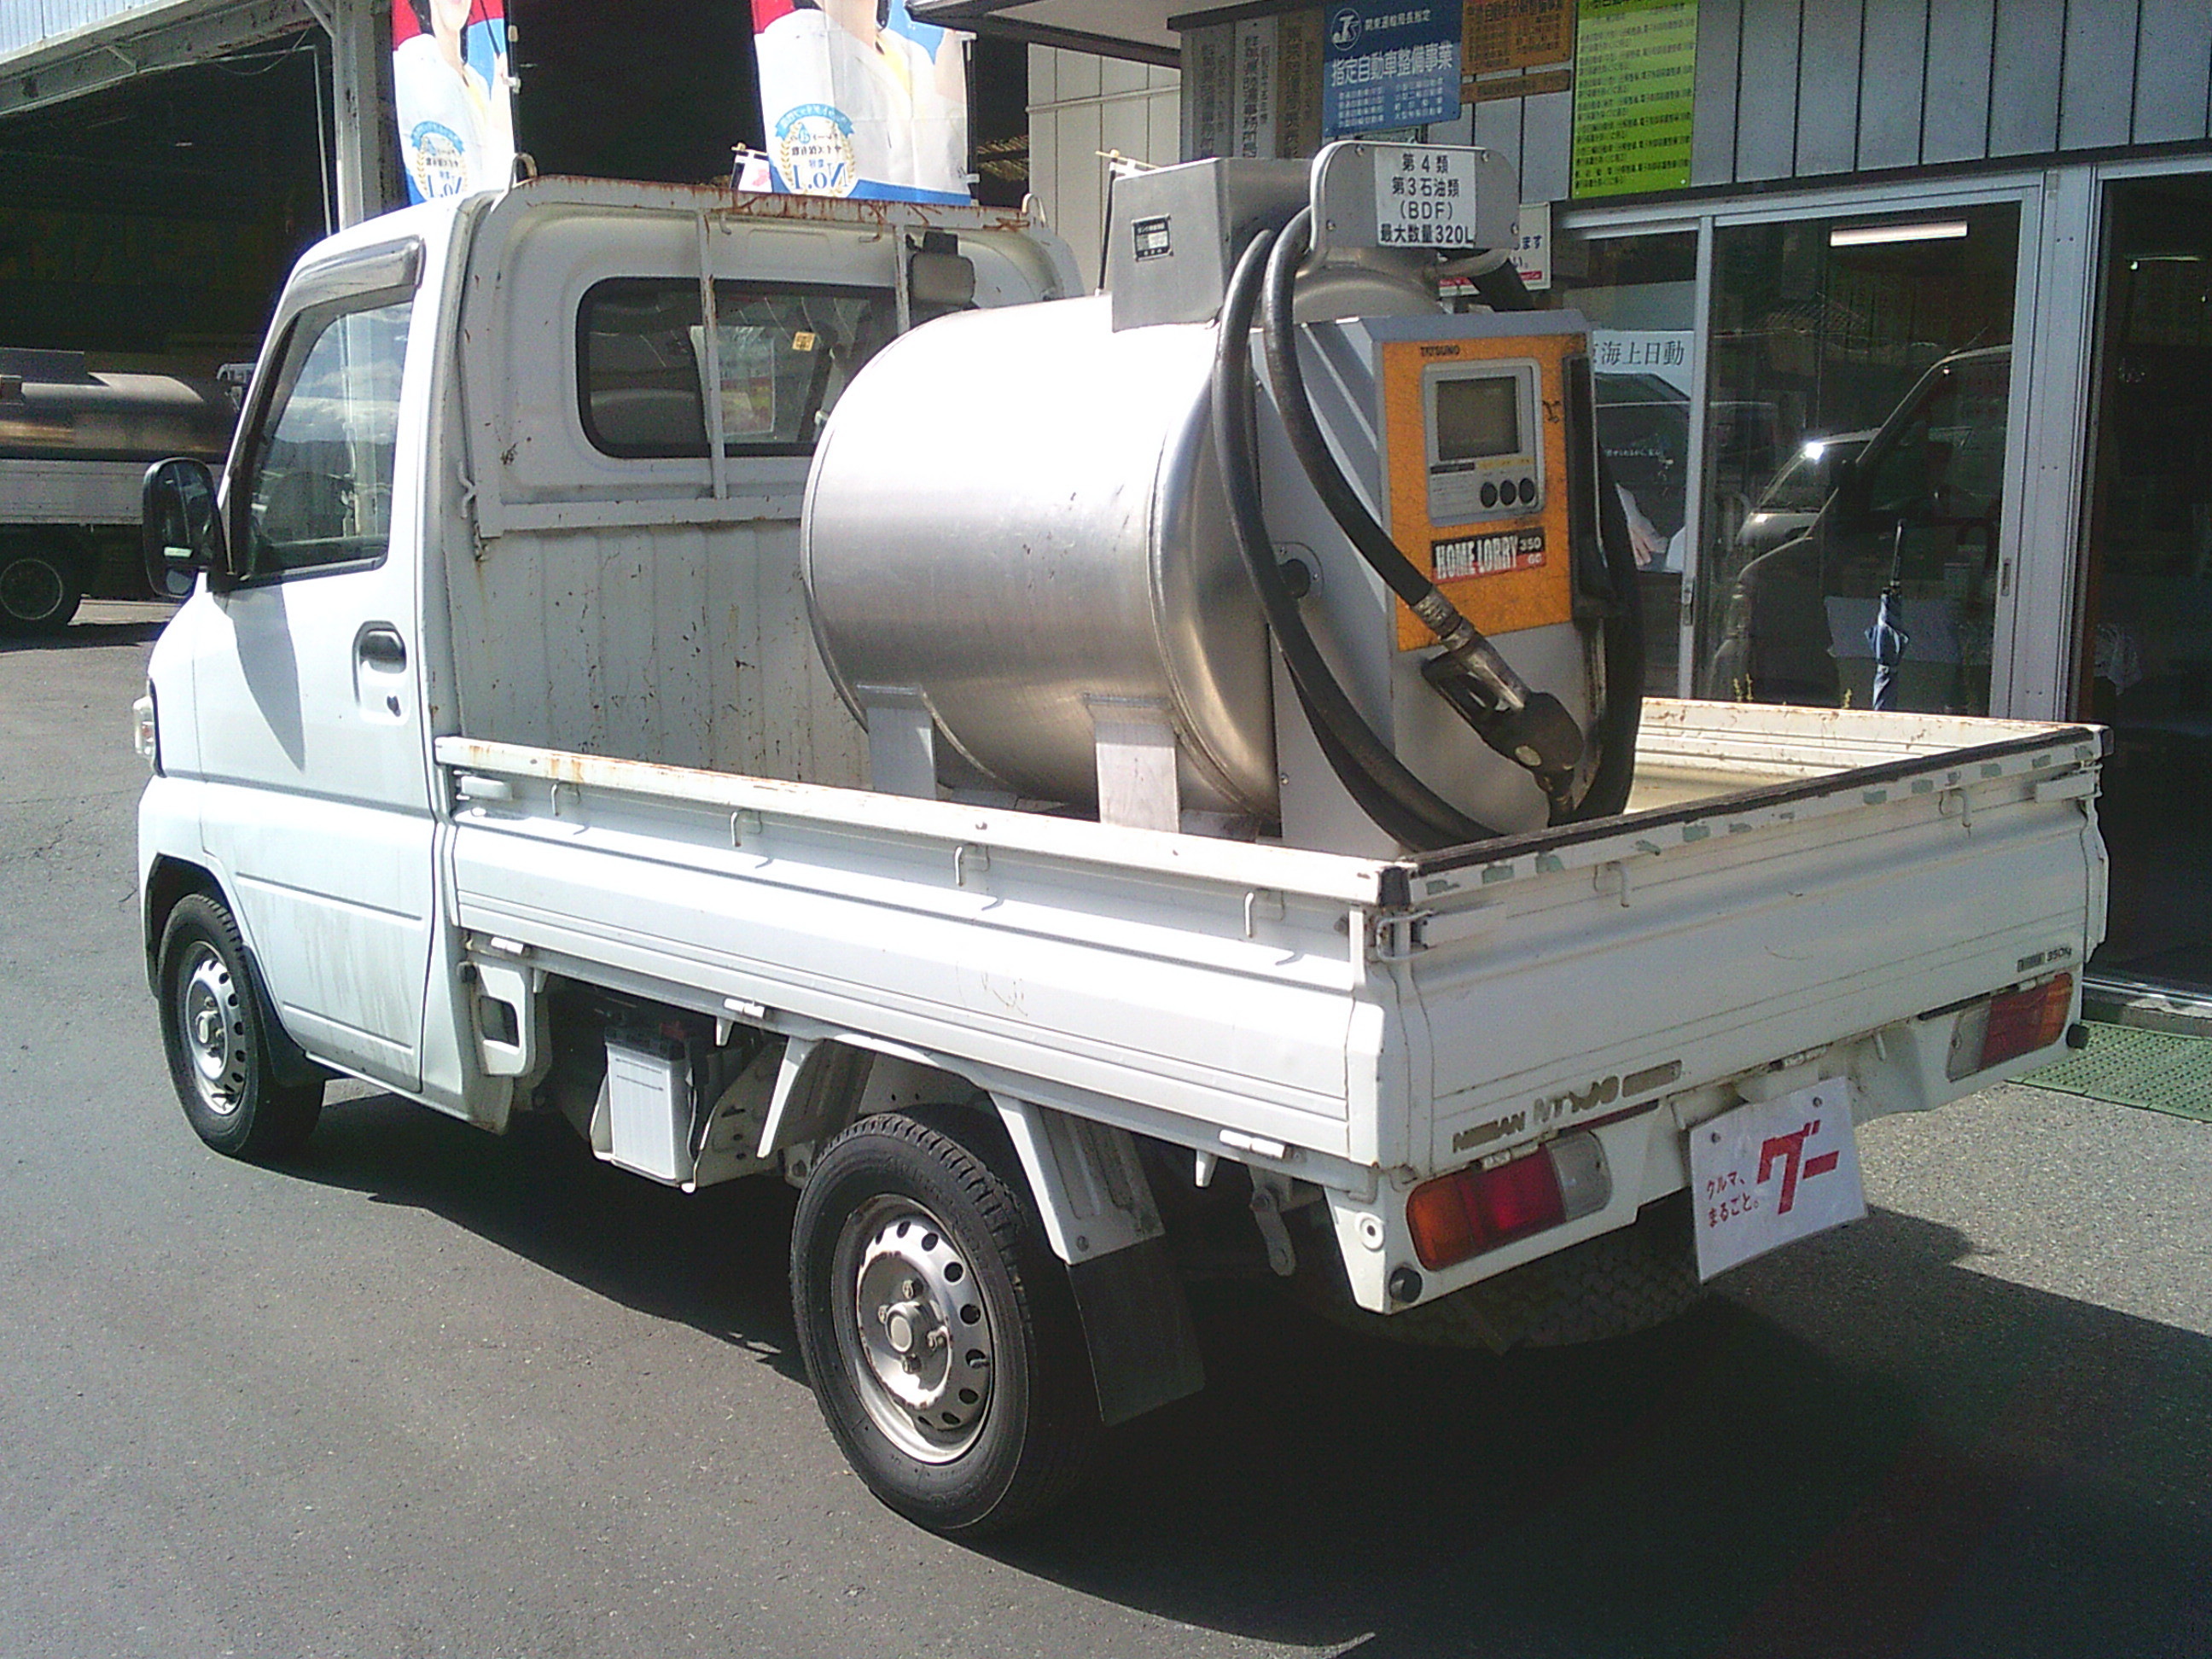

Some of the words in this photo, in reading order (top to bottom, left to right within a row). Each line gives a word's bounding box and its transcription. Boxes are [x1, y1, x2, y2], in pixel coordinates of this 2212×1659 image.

[1392, 177, 1460, 197] 第3石油類
[1400, 201, 1452, 220] (BDF)
[1380, 223, 1475, 244] 最大数量320L
[1435, 540, 1476, 579] HOME
[1476, 534, 1518, 573] LORRY
[1519, 537, 1542, 551] 350
[1707, 1171, 1745, 1201] クルマ、
[1708, 1192, 1759, 1228] まるごと。
